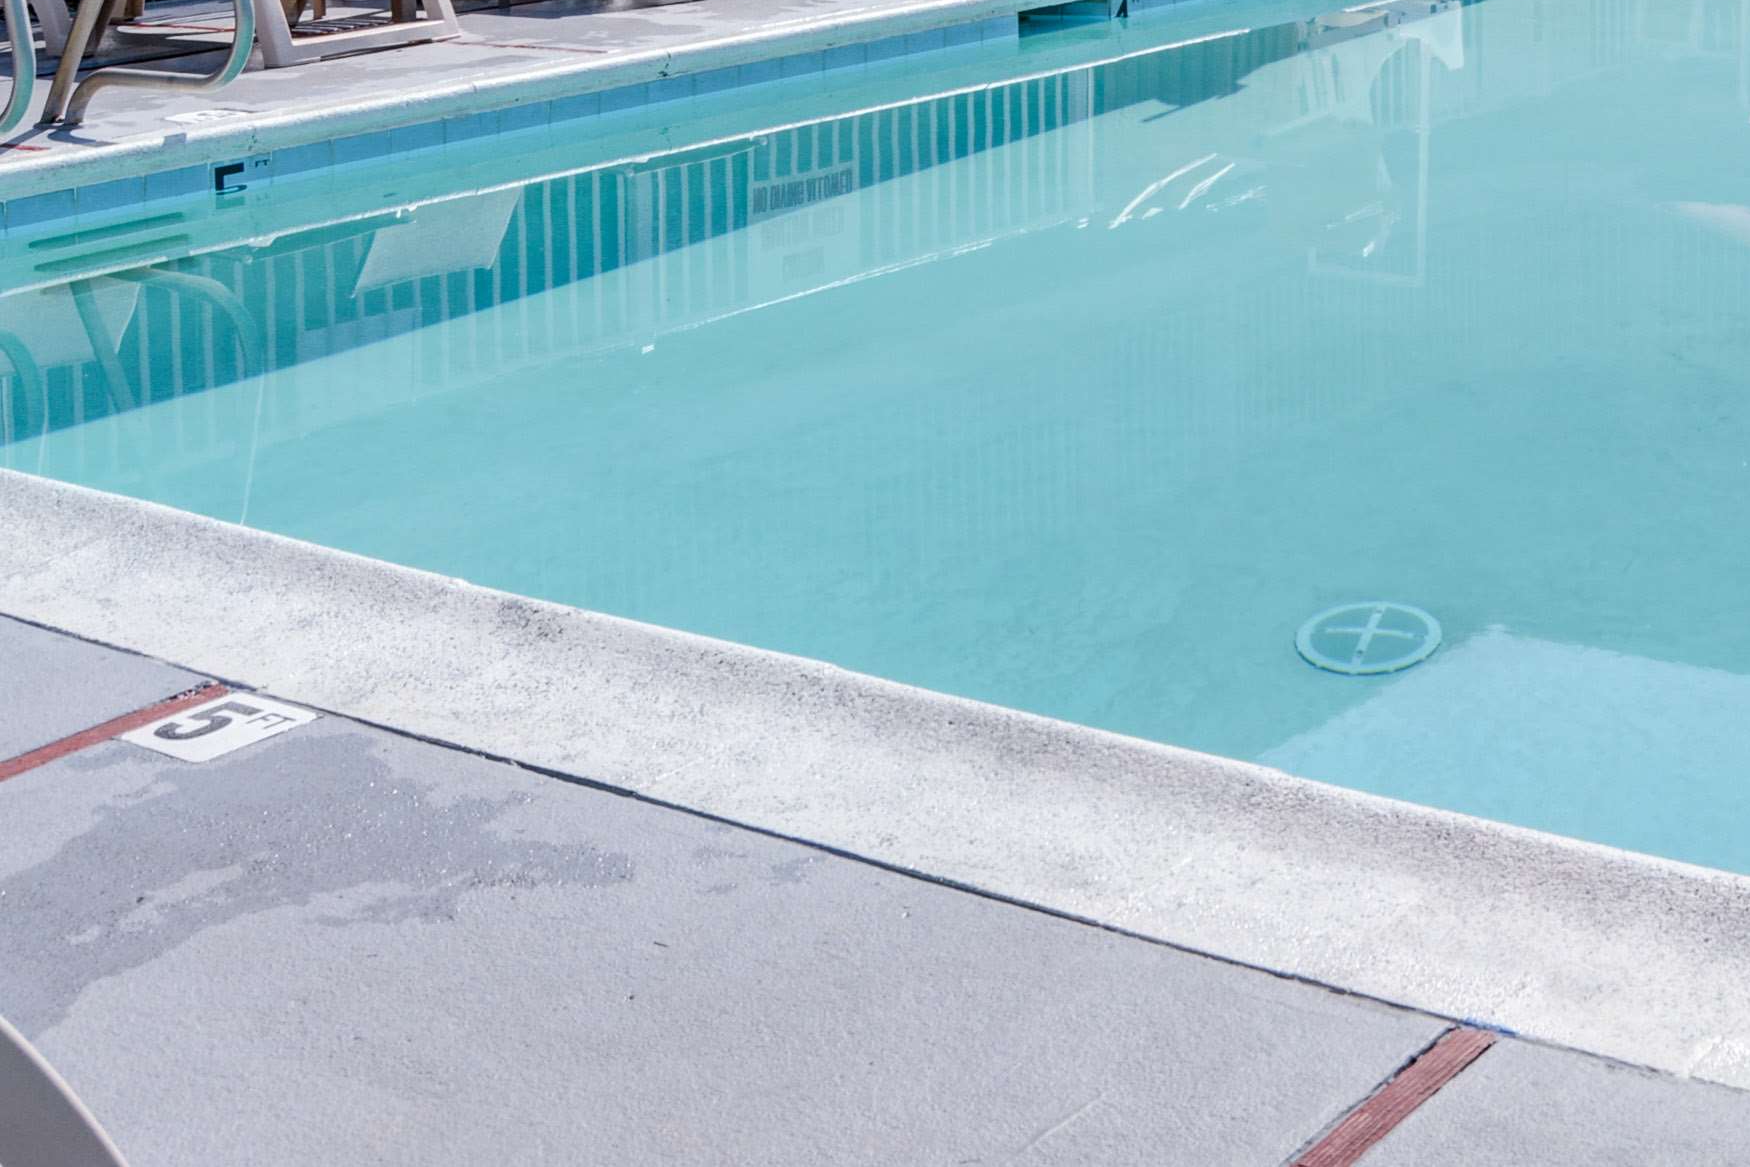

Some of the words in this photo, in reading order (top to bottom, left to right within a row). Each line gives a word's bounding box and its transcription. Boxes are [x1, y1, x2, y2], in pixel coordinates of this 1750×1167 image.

[214, 162, 248, 196] 5
[153, 700, 264, 741] 5
[246, 712, 297, 729] FT
